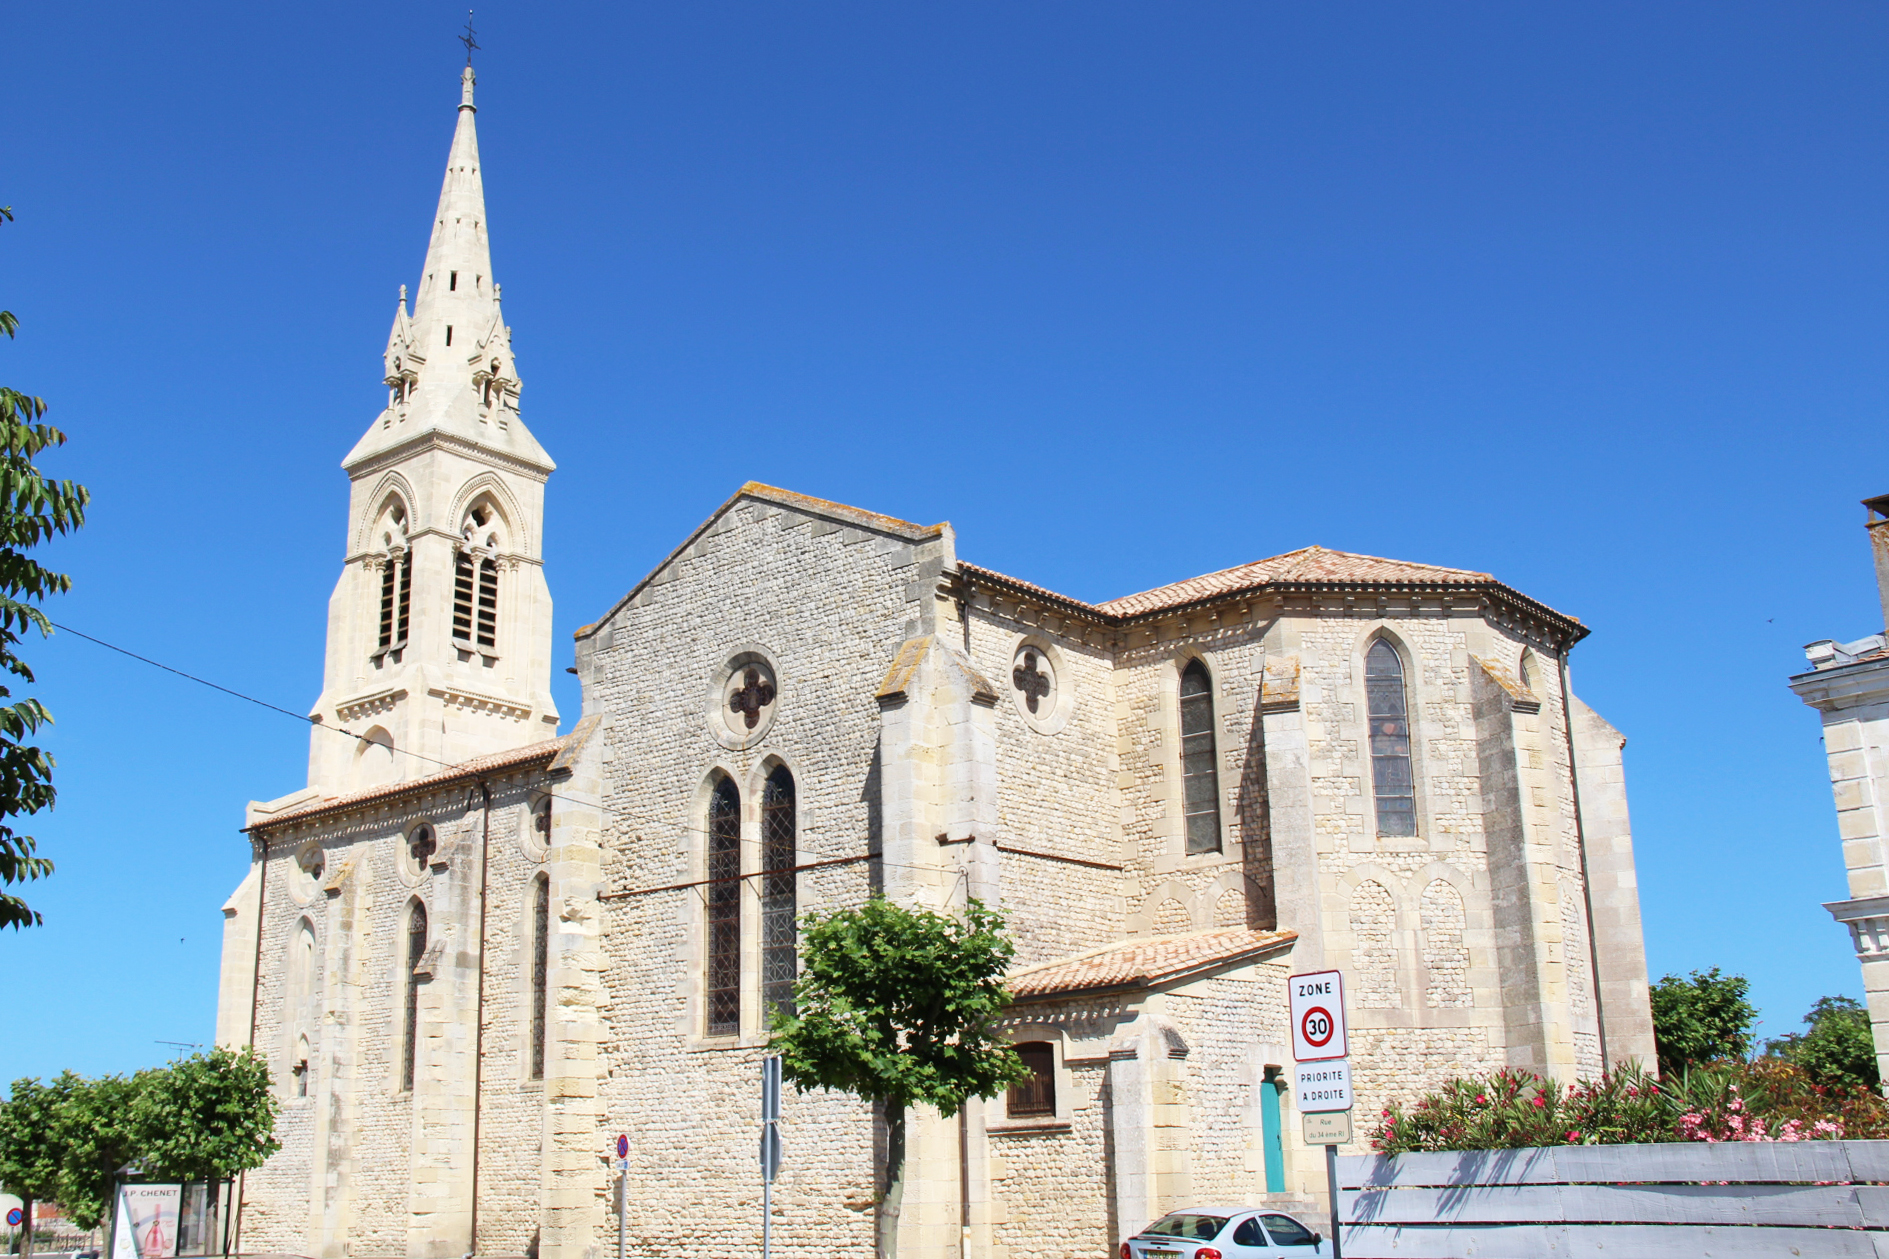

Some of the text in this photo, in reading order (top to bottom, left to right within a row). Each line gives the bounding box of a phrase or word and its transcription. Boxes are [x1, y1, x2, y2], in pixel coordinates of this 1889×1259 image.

[1299, 982, 1331, 997] ZONE
[1309, 1018, 1327, 1036] 30
[1301, 1071, 1342, 1082] PRIORITE
[1303, 1089, 1344, 1101] A DROITE
